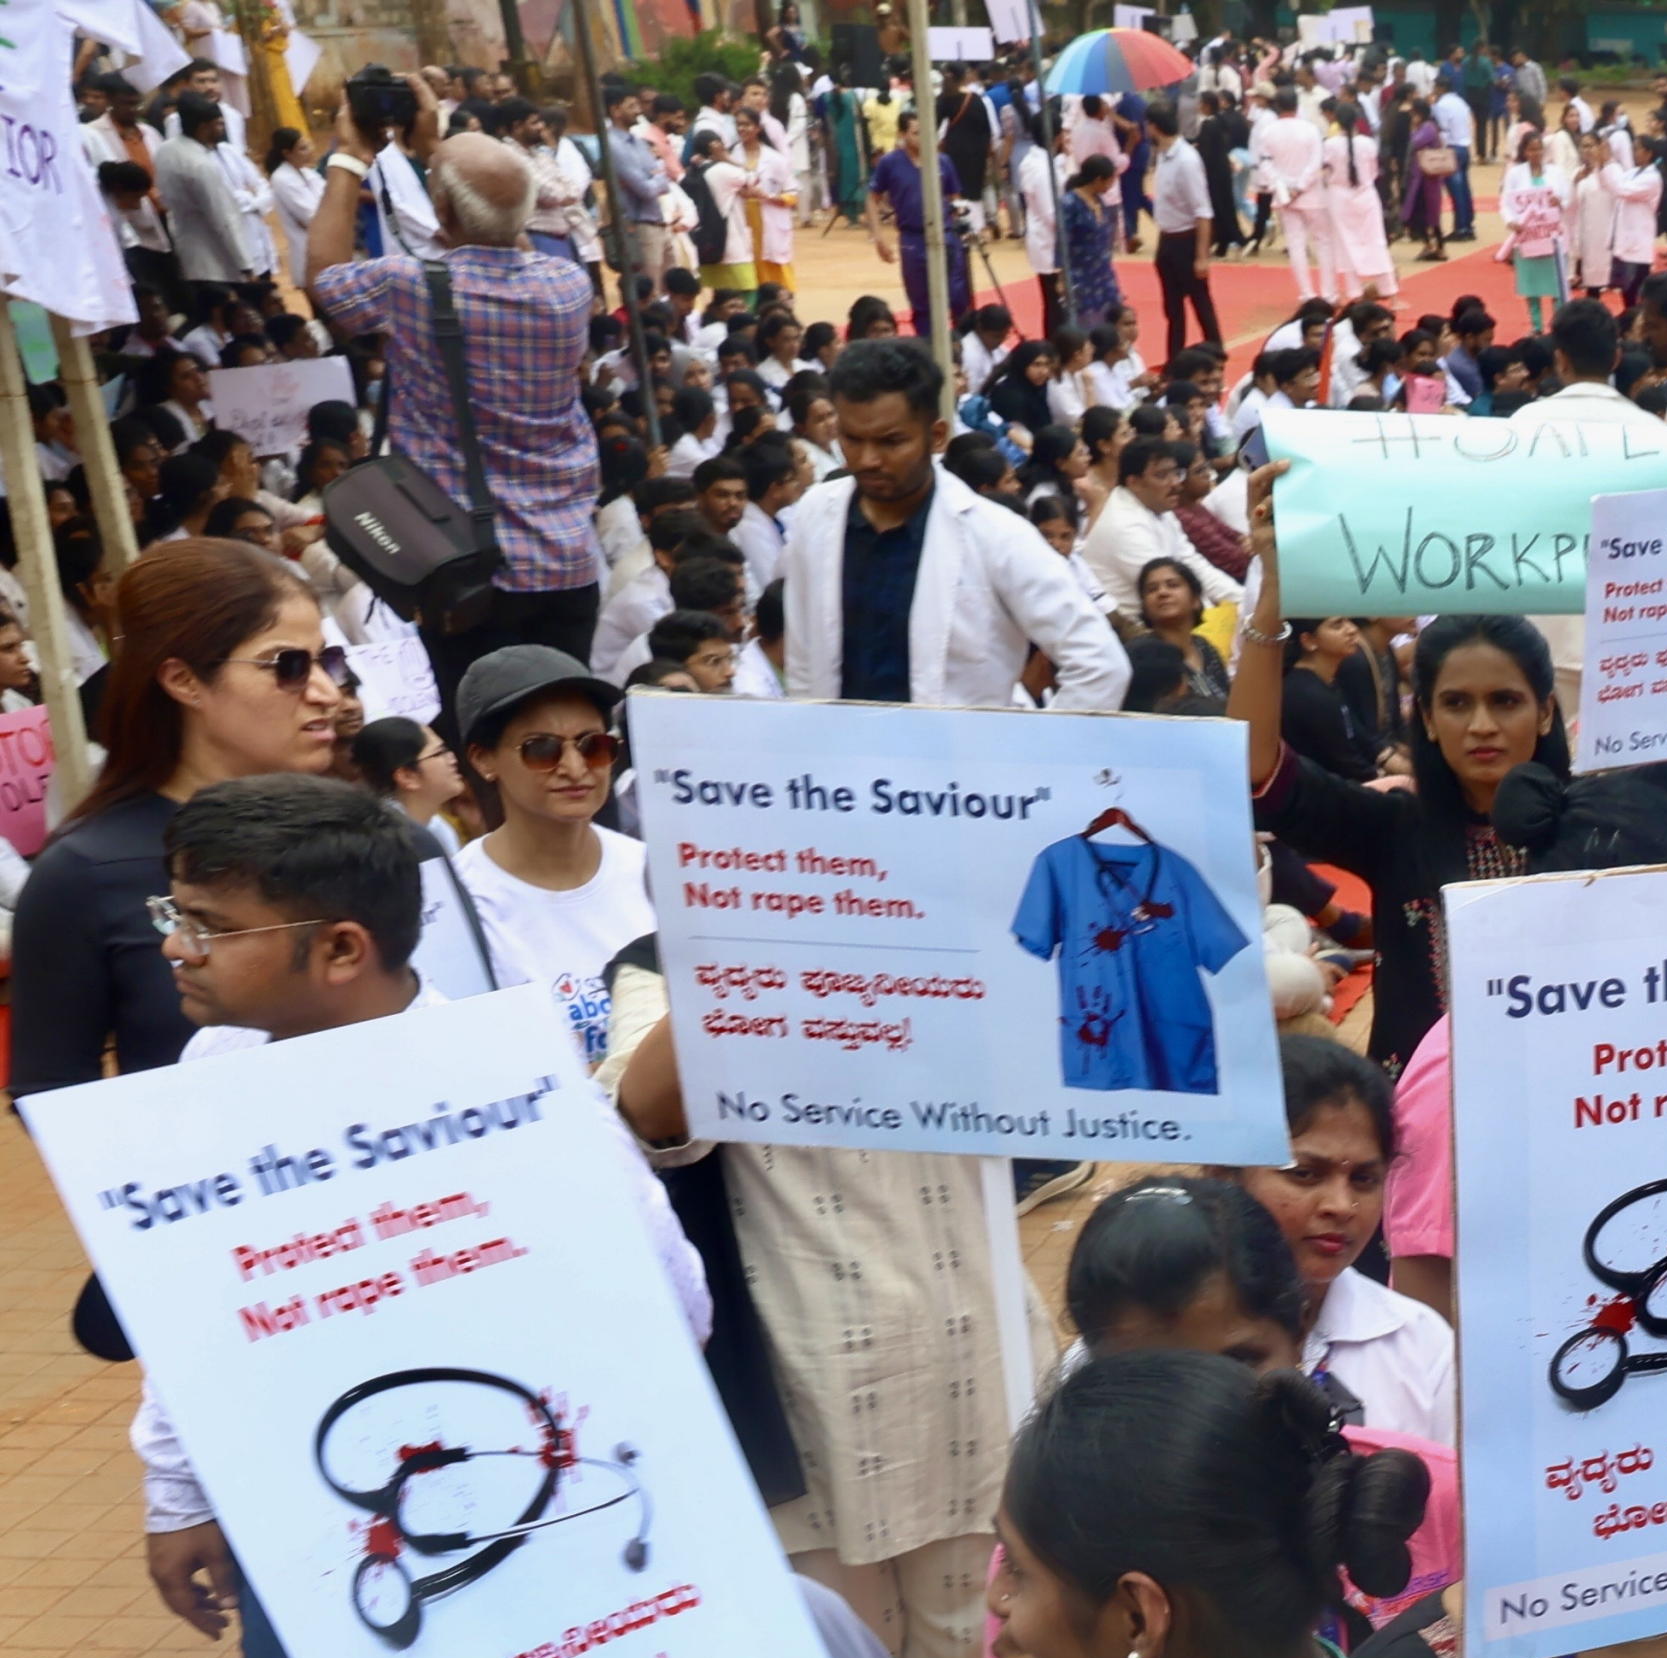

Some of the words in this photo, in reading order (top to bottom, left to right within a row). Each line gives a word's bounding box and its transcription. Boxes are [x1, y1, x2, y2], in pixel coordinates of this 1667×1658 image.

[354, 511, 402, 557] Nikon
[1601, 538, 1662, 559] "Save
[1605, 579, 1663, 598] Protect
[1604, 607, 1634, 622] Not
[655, 770, 772, 808] "Save
[787, 774, 854, 812] the
[872, 779, 1049, 819] Saviour"
[678, 842, 786, 871] Protect
[796, 848, 886, 881] them,
[684, 882, 741, 908] Not
[752, 893, 823, 918] rape
[834, 889, 924, 918] them.
[1488, 975, 1626, 1018] "Save
[717, 1092, 769, 1122] No
[782, 1094, 901, 1129] Service
[910, 1102, 1050, 1136] Without
[1063, 1109, 1191, 1140] Justice.
[1575, 1093, 1641, 1128] Not
[104, 1174, 241, 1230] "Save
[251, 1145, 333, 1195] the
[346, 1076, 553, 1169] Saviour"
[234, 1224, 360, 1272] Protect
[371, 1192, 482, 1238] them,
[239, 1299, 307, 1341] Not
[319, 1273, 402, 1311] rape
[412, 1238, 526, 1284] them.
[1501, 1594, 1548, 1624] No
